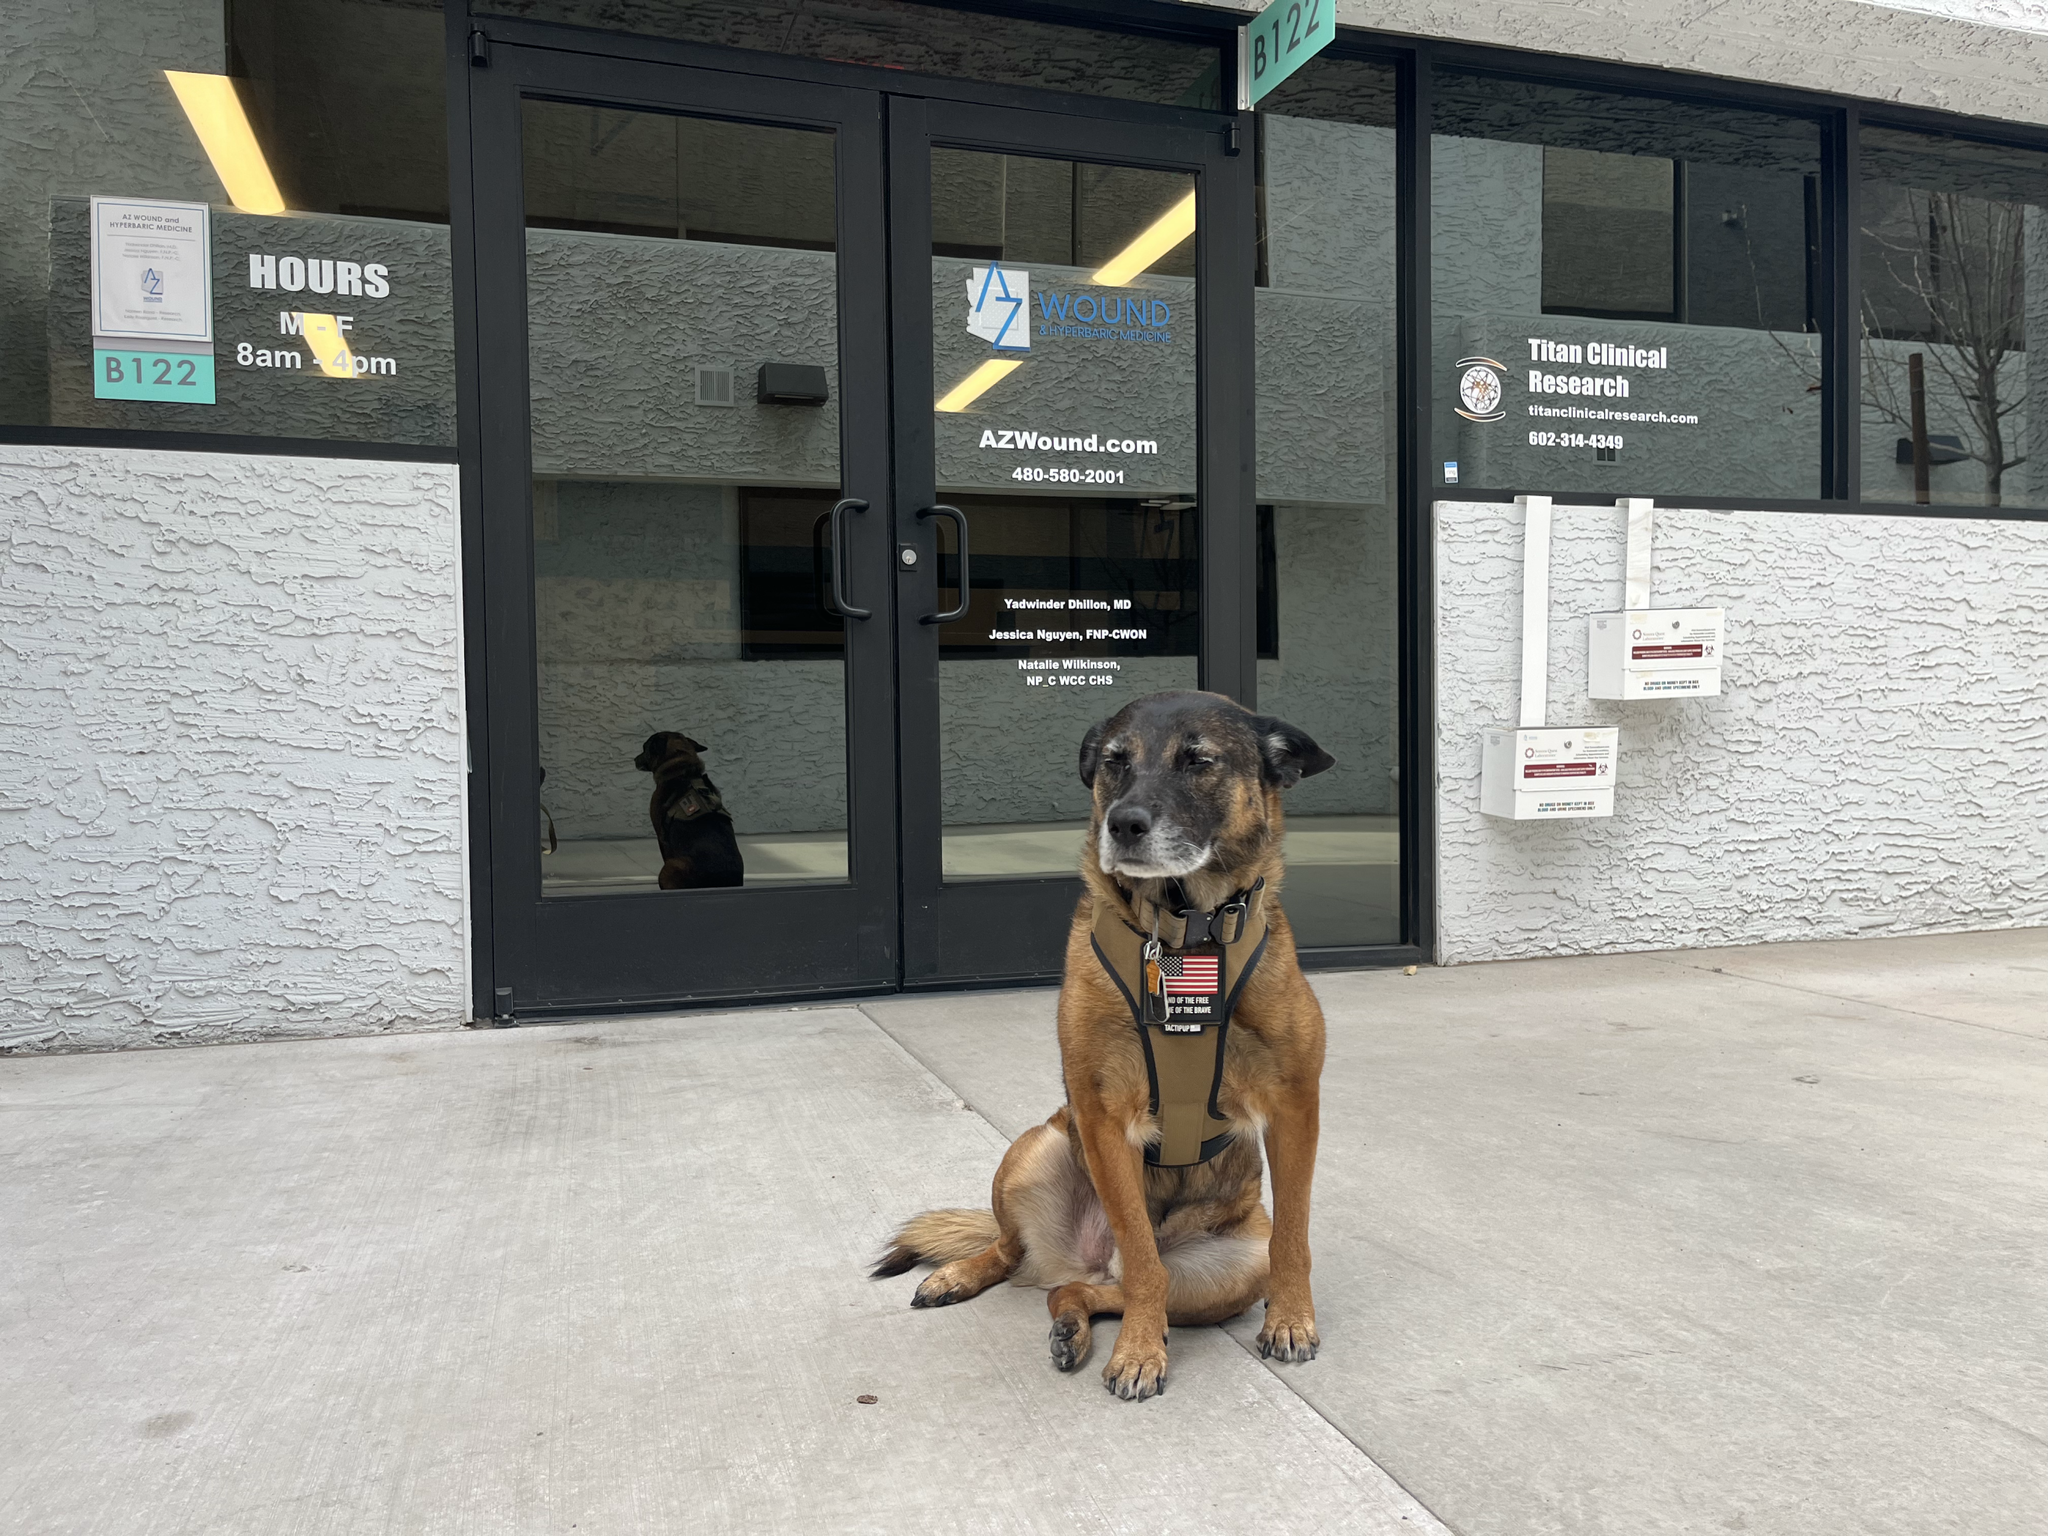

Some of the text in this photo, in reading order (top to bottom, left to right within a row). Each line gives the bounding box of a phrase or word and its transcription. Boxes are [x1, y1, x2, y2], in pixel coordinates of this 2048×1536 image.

[1254, 0, 1320, 81] B122
[109, 222, 193, 233] HYPERBARIC MEDICINE
[249, 254, 390, 298] HOURS
[975, 261, 1031, 352] AZ
[1038, 292, 1170, 327] WOUND
[280, 311, 304, 336] M
[336, 315, 354, 338] F
[1039, 324, 1171, 343] & HYPERBARIC MEDICINE
[236, 342, 302, 369] 8am
[332, 349, 397, 378] 4pm
[1528, 338, 1667, 369] Titan Clinical
[106, 356, 197, 387] B122
[1528, 370, 1630, 398] Research
[1528, 404, 1698, 425] titanclinicalresearch.com
[979, 430, 1158, 454] AZWound.com
[1528, 431, 1624, 450] 602-314-4349
[1012, 467, 1124, 484] 480-580-2001
[1004, 598, 1132, 611] Yadwinder Dhillon, MD
[988, 629, 1147, 642] Jessica Nguyen, FNP-CWON
[1018, 659, 1120, 671] Natalie Wilkinson,
[1026, 676, 1114, 688] NP_C WCC CHS
